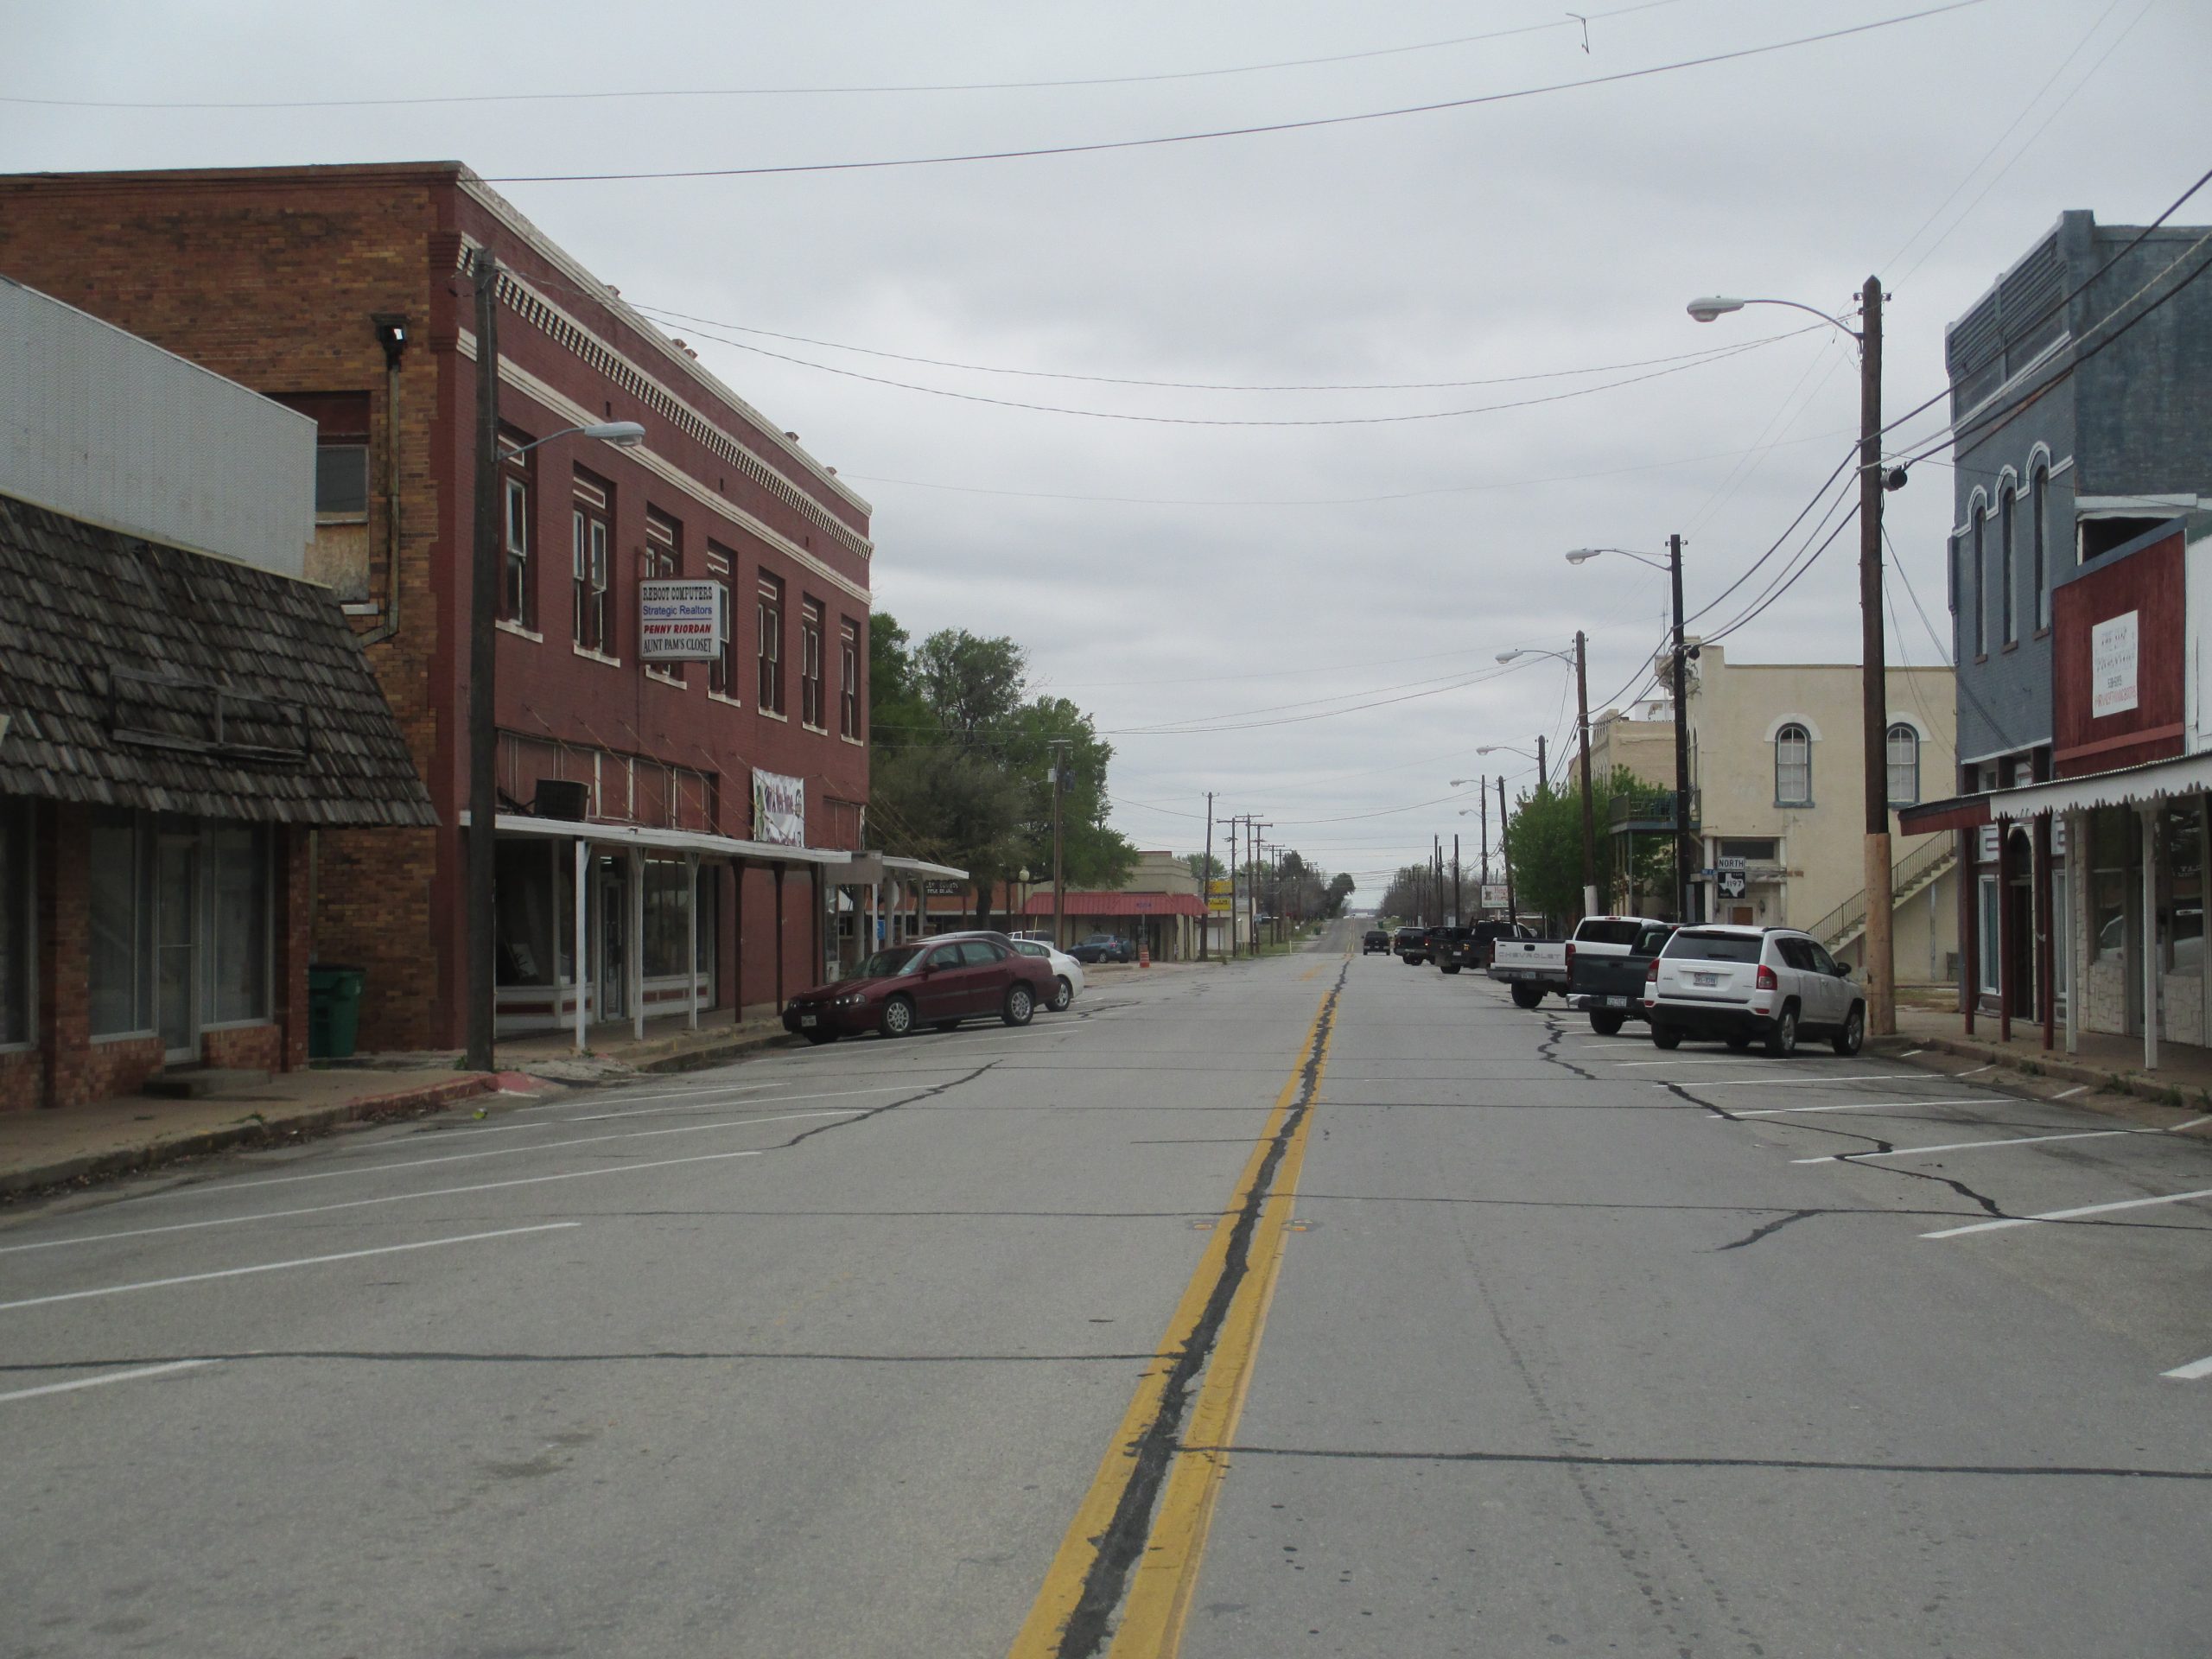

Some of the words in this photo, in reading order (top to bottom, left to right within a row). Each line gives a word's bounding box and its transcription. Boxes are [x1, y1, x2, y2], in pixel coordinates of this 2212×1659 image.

[643, 588, 670, 601] REBOOT
[671, 587, 713, 601] COMPUTERS
[643, 606, 677, 617] Strategic
[679, 605, 712, 614] Realtors
[644, 625, 671, 633] PENNY
[674, 624, 711, 633] RIORDAN
[643, 639, 663, 654] AUNT
[664, 639, 684, 651] PAM'S
[687, 639, 712, 652] CLOSET
[1719, 859, 1744, 868] NORTH
